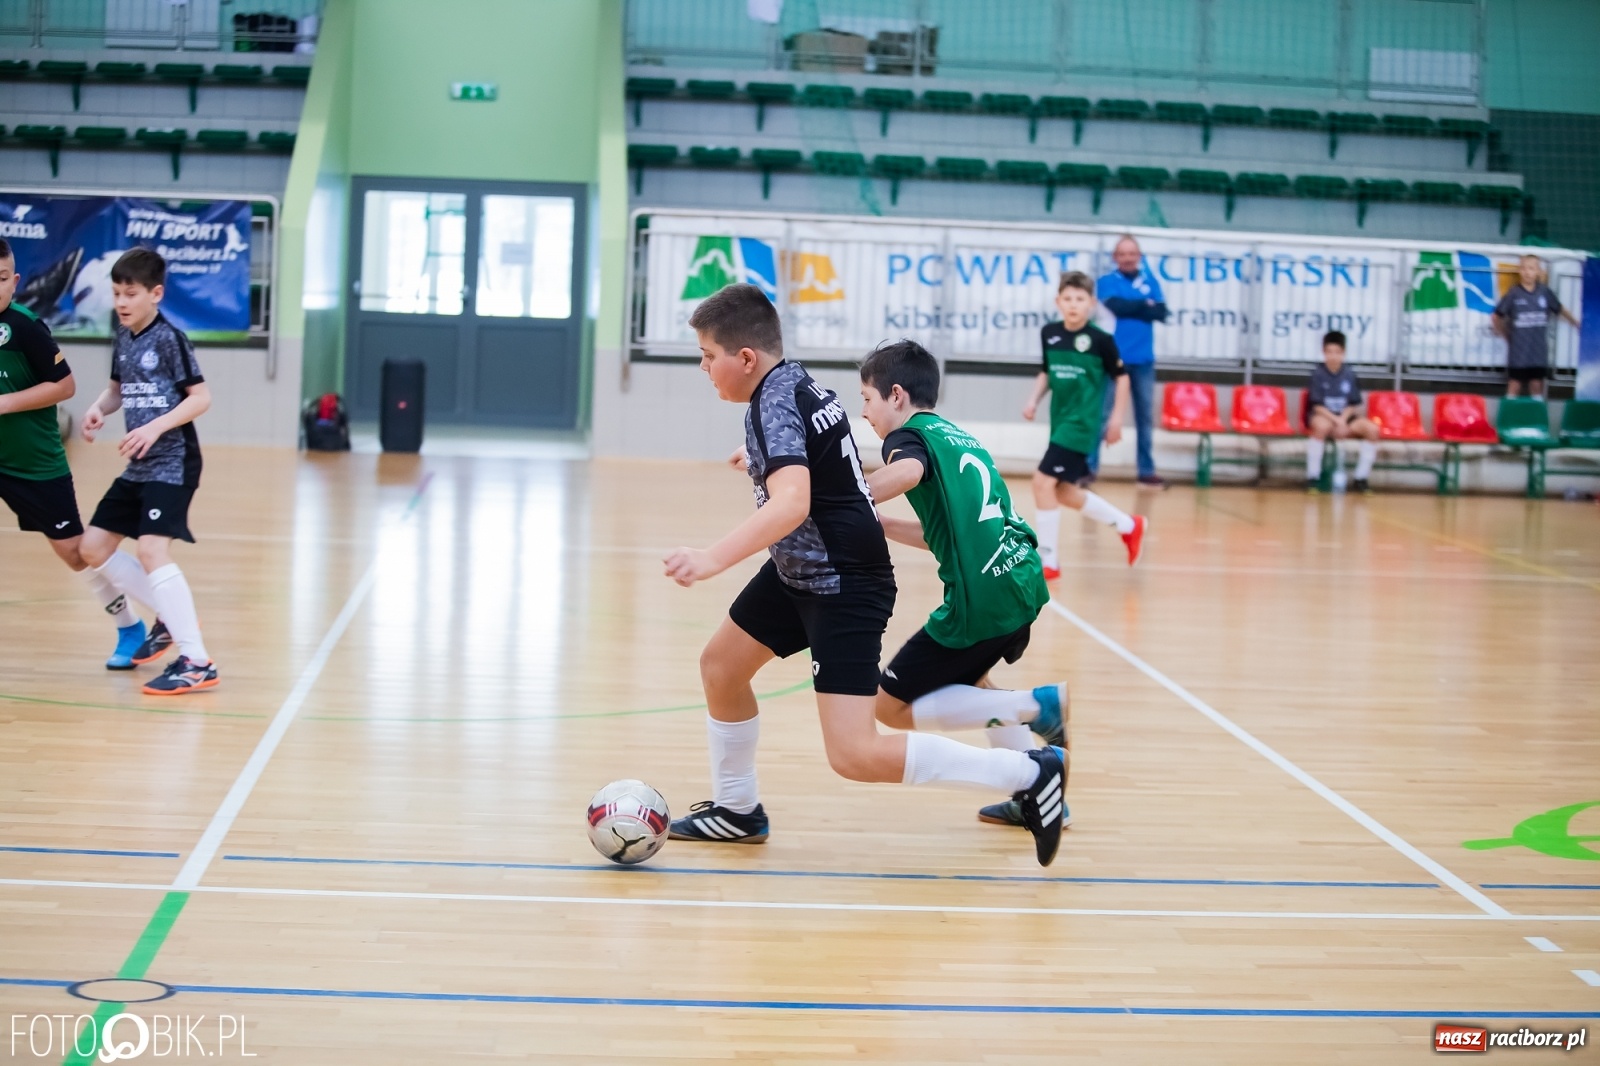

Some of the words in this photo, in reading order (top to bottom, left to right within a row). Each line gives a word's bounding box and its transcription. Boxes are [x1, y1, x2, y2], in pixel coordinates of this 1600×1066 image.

[161, 222, 225, 241] SPORT
[1094, 251, 1371, 288] RCIBORSKI
[1271, 310, 1374, 339] gramy
[839, 432, 880, 522] 1
